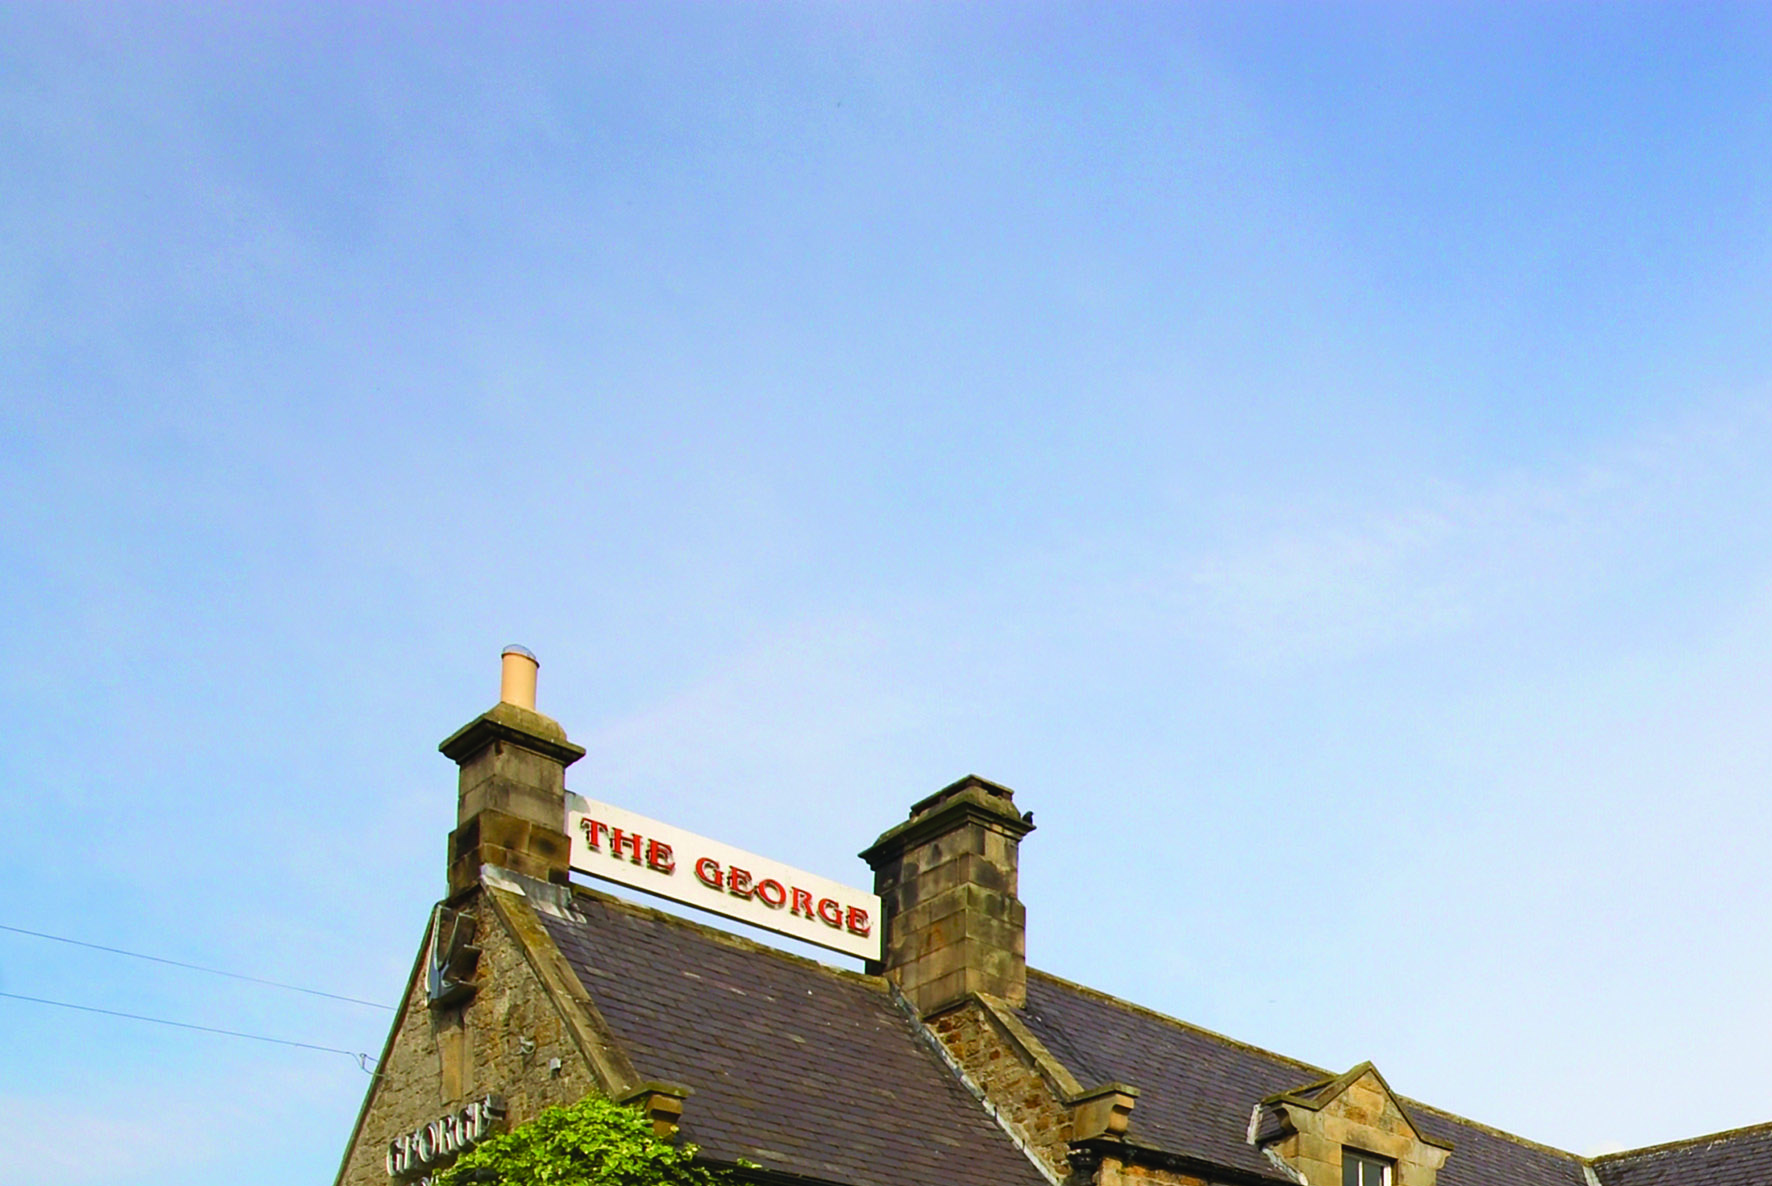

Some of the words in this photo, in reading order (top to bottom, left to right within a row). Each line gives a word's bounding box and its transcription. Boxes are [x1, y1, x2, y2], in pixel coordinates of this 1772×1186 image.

[580, 817, 676, 875] THE
[694, 856, 871, 938] GEORGE
[386, 1093, 507, 1177] GEORGE
